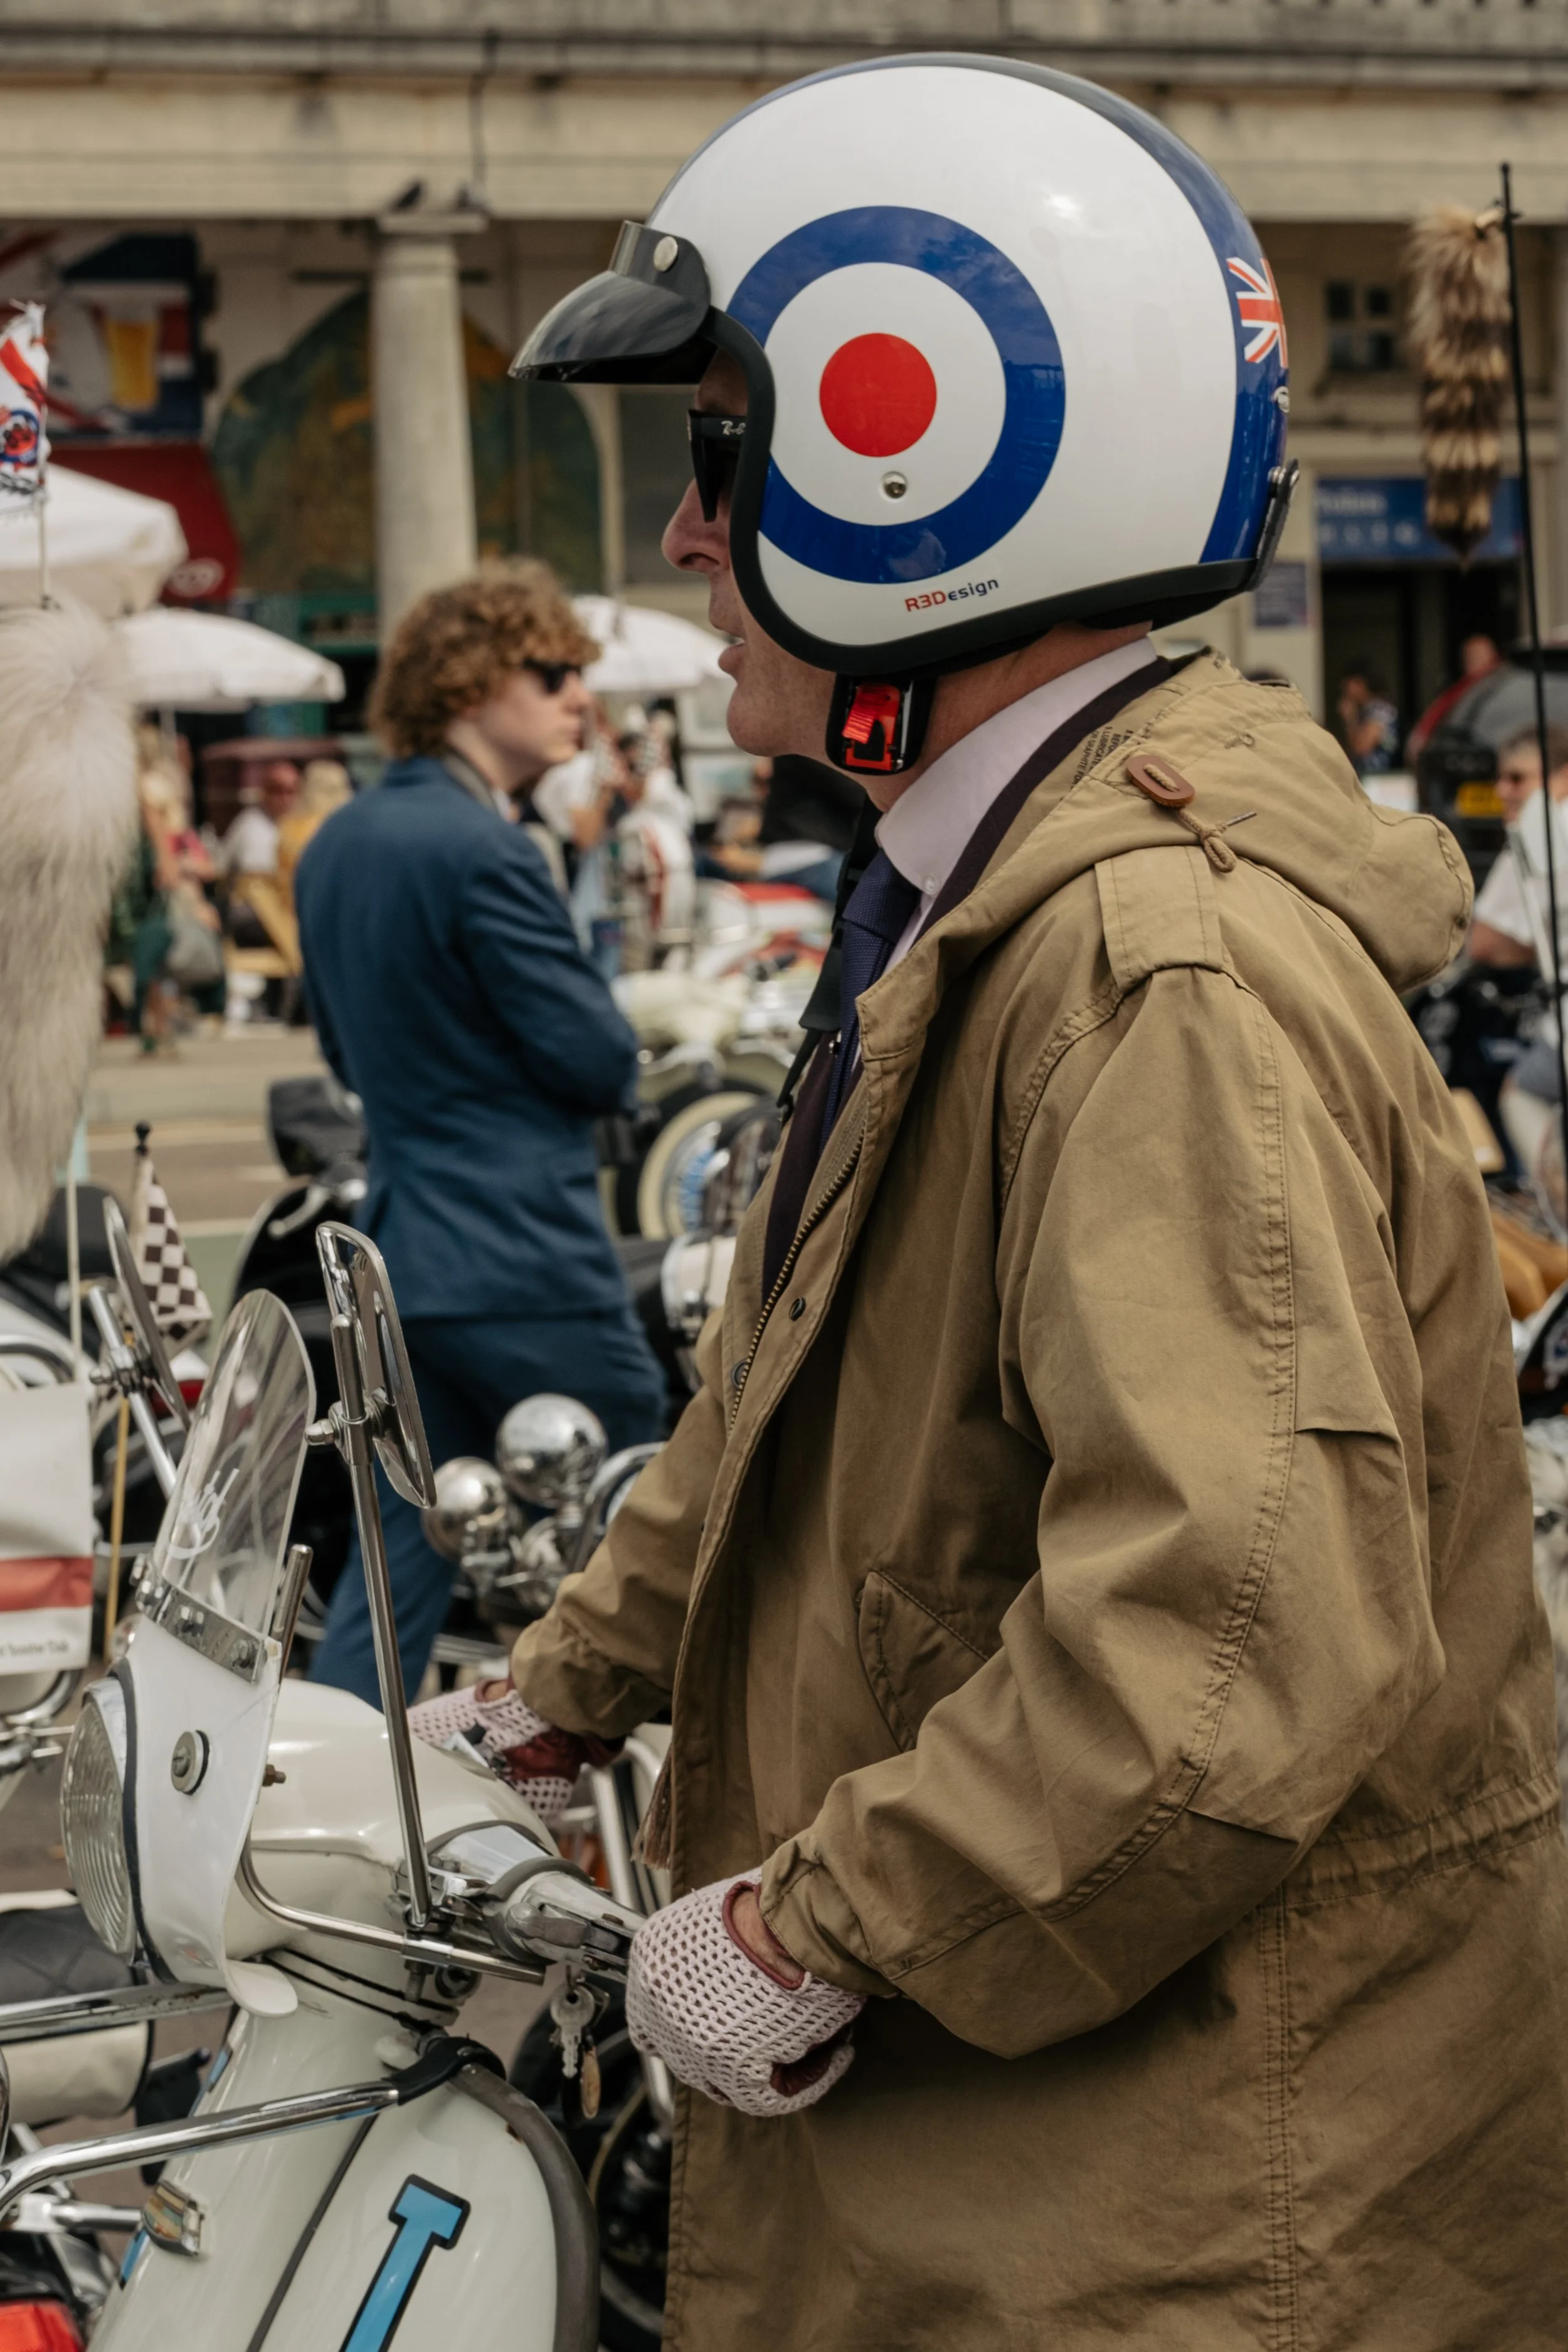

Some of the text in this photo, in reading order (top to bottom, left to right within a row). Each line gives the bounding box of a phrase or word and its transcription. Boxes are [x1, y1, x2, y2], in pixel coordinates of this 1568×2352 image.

[1077, 739, 1095, 771] GRAPHITE
[1092, 731, 1110, 766] LUBRICATE
[1106, 733, 1121, 755] BEFO
